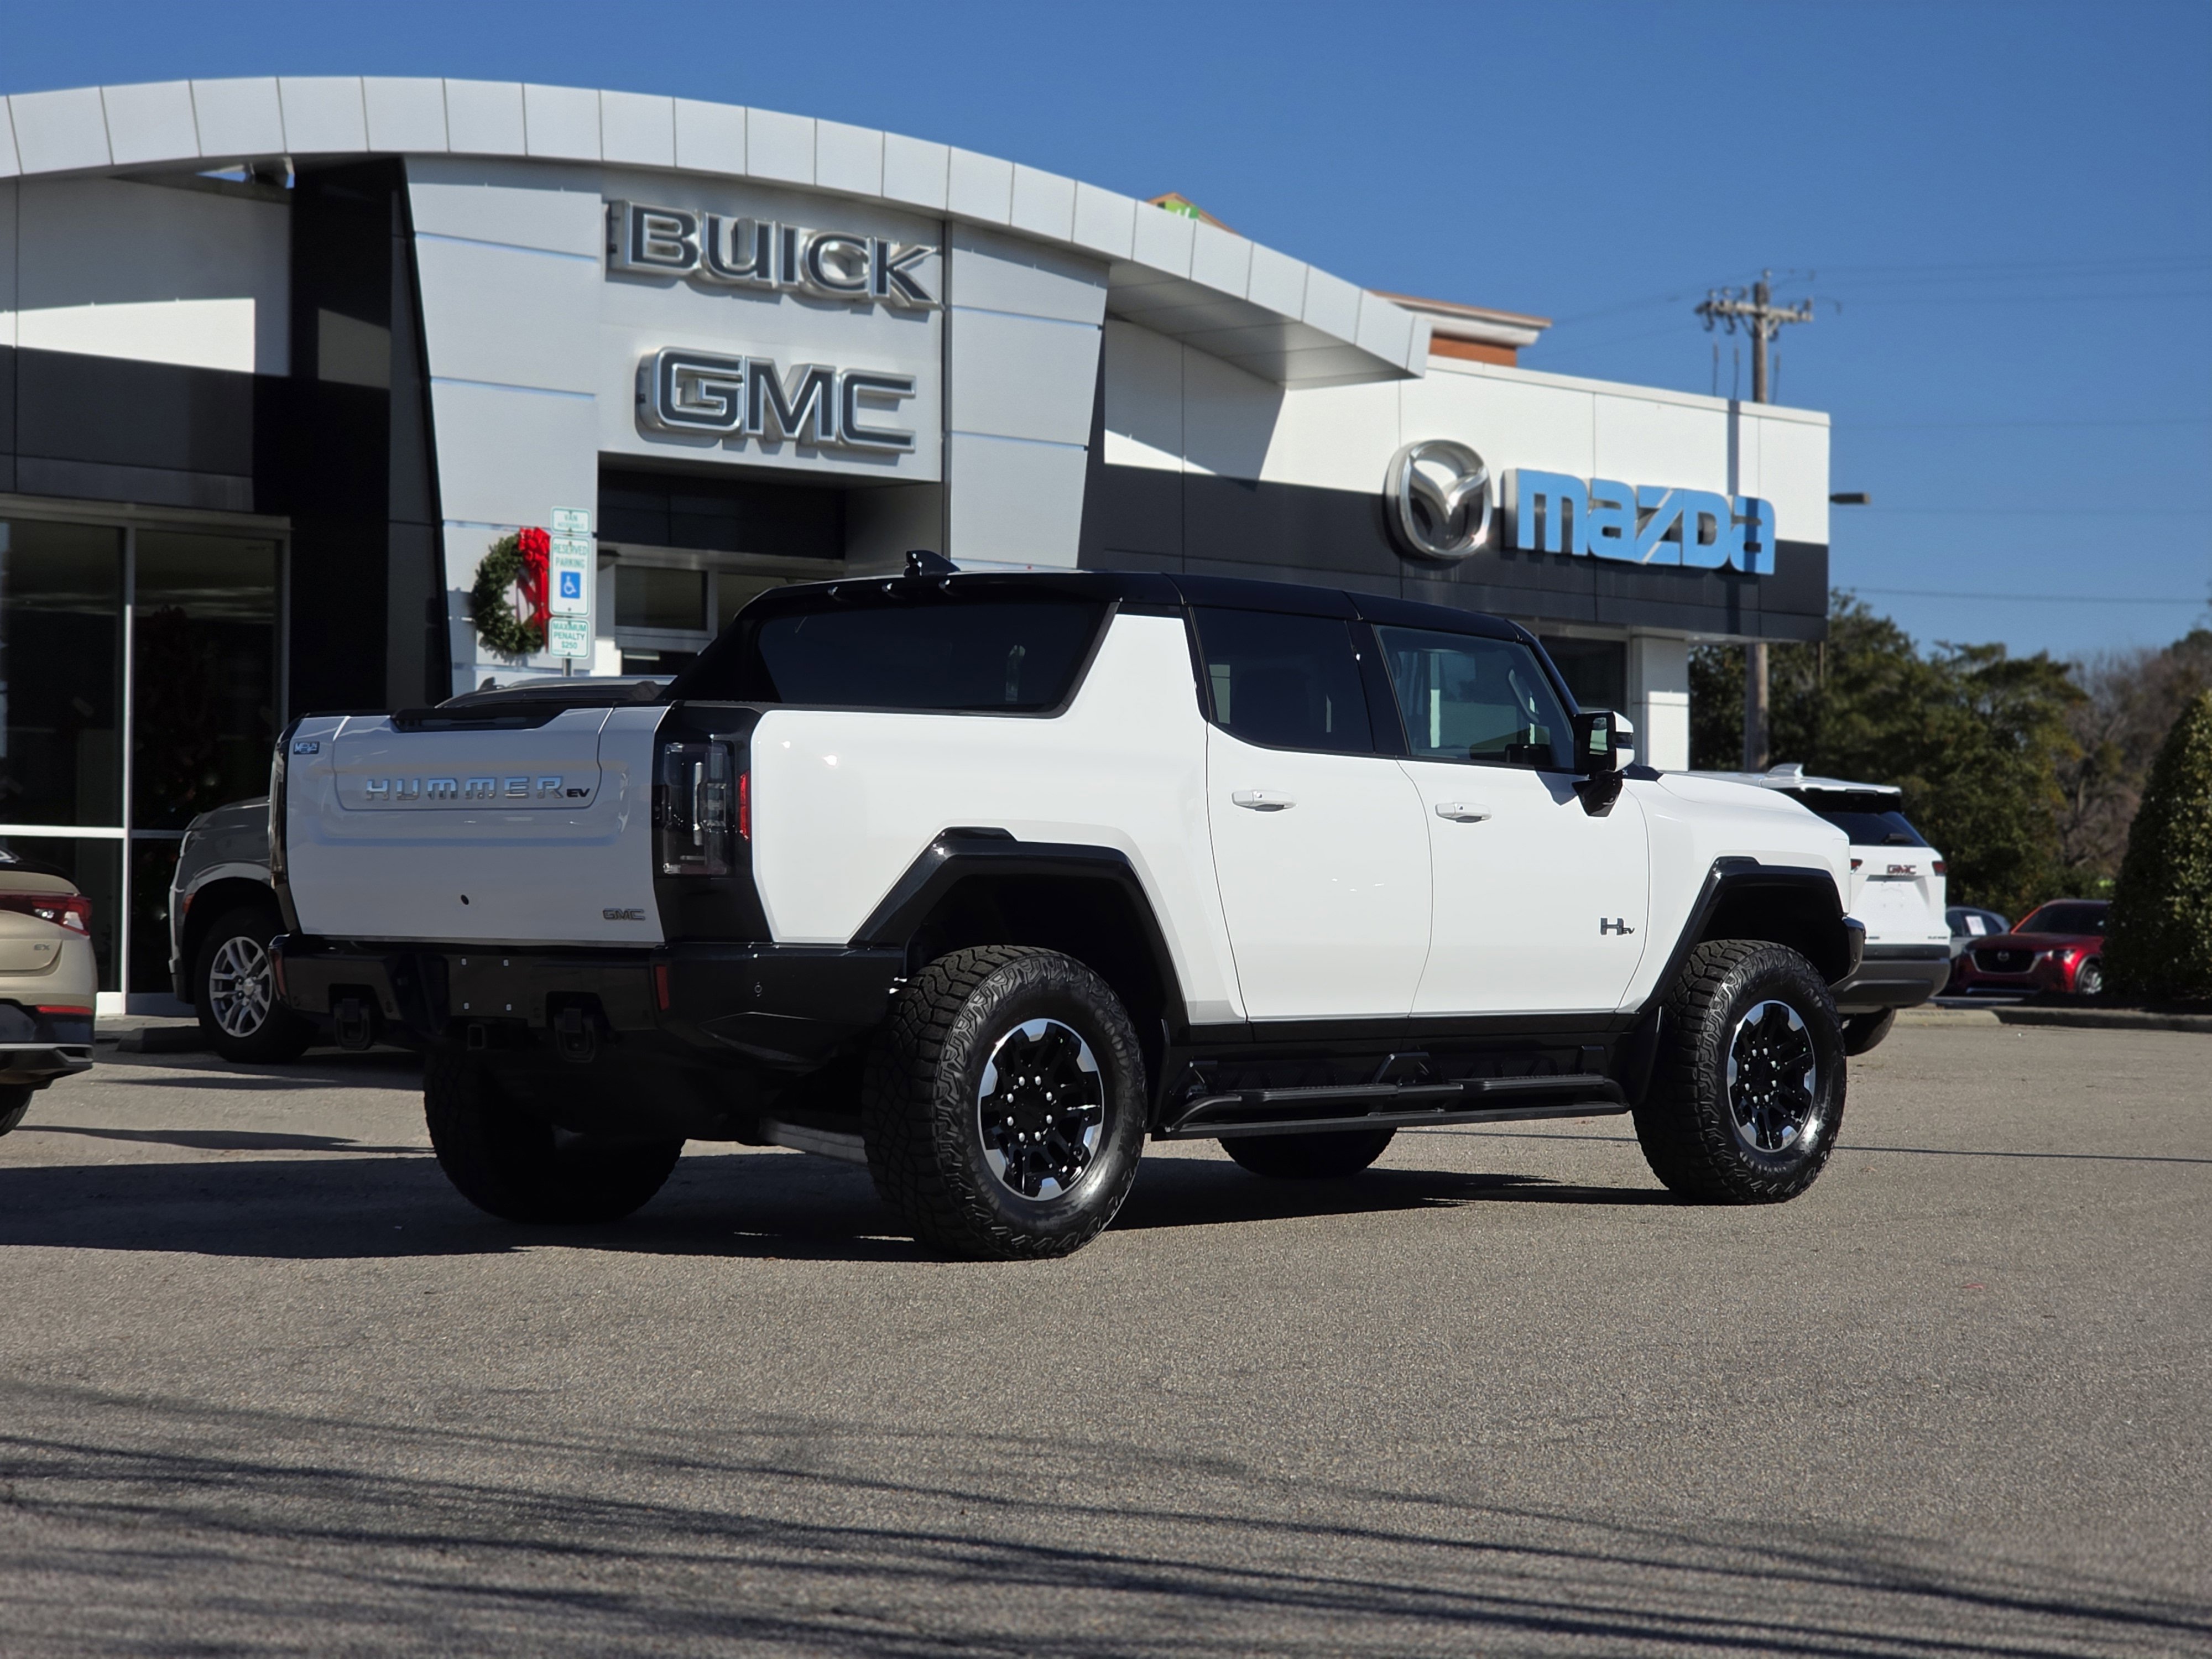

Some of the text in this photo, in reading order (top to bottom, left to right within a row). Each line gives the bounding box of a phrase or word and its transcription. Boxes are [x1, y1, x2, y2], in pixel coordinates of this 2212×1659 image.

[625, 201, 942, 311] BUICK
[656, 346, 916, 454] GMC
[556, 557, 585, 568] PARKING
[553, 623, 586, 632] MAXIMUM
[554, 632, 585, 641] PENALTY
[366, 776, 591, 801] HUMMER EV
[1886, 864, 1917, 875] GMC
[602, 907, 646, 922] GMC
